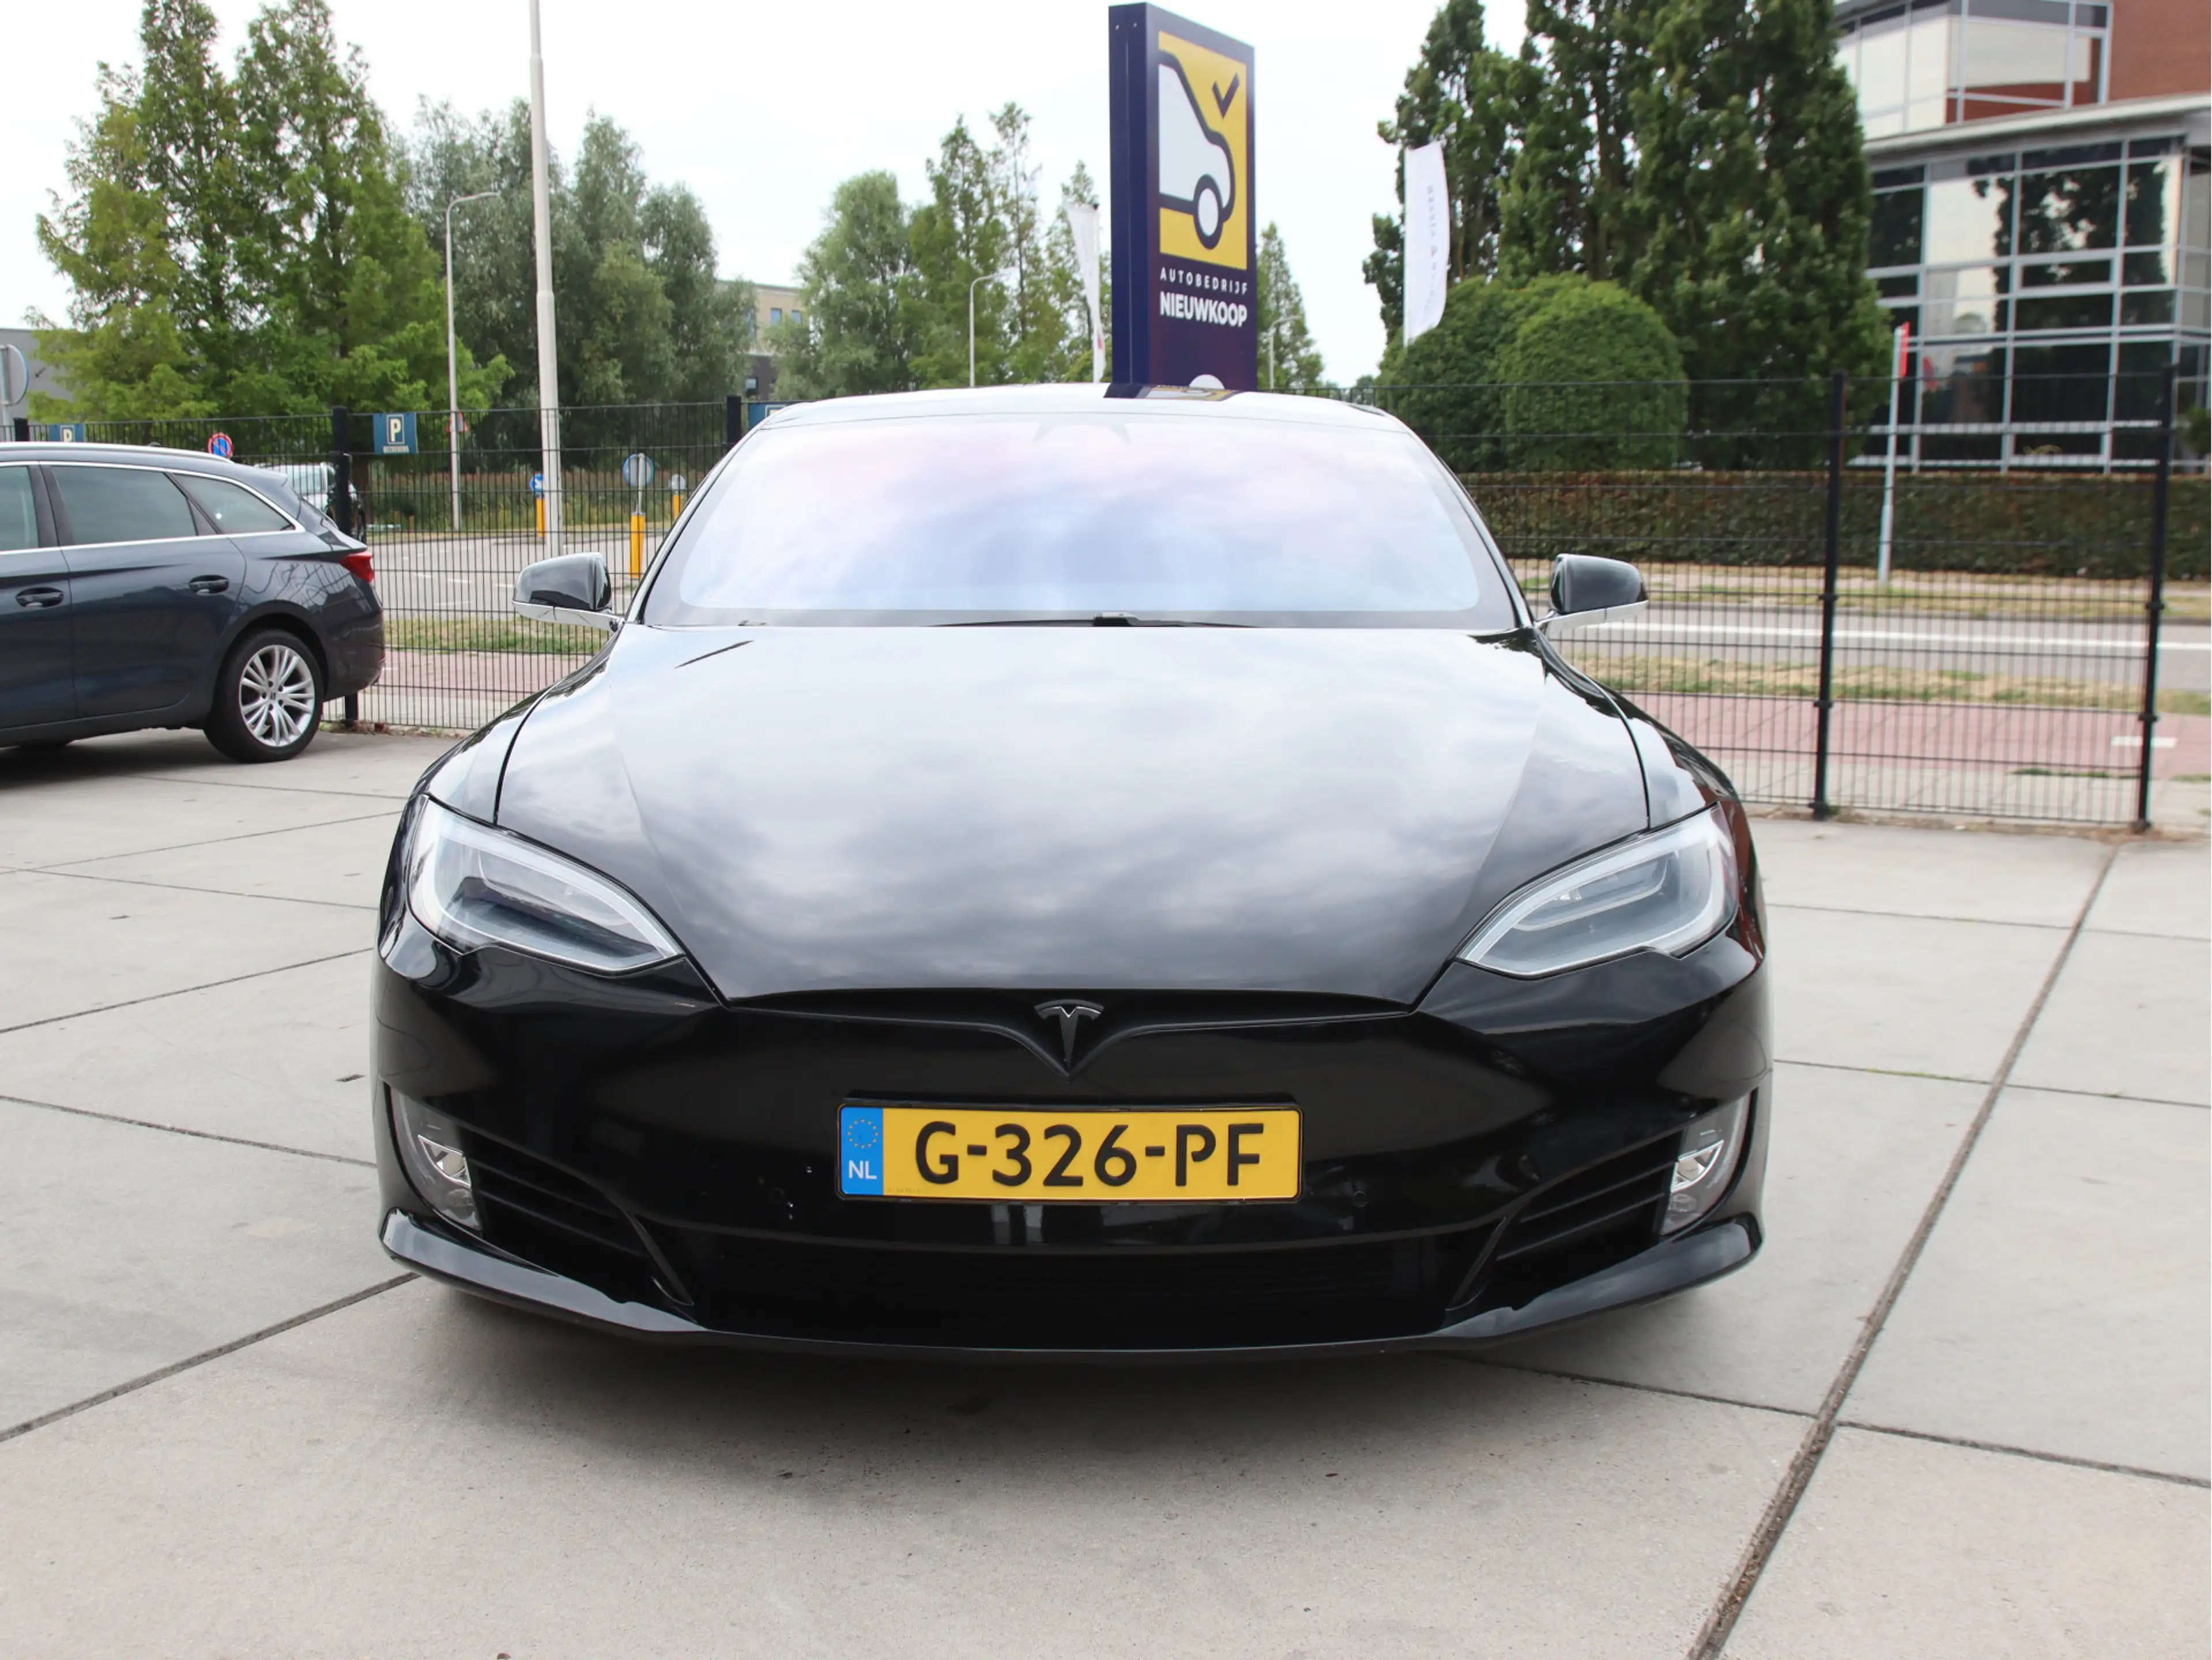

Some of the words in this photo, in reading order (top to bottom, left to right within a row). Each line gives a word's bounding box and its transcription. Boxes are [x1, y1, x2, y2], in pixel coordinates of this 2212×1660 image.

[1160, 267, 1248, 295] AUTOBEDRIJF
[1160, 290, 1248, 327] NIEUWKOOP
[390, 418, 402, 442] P
[915, 1121, 1264, 1187] G-326-PF
[849, 1160, 877, 1180] NL
